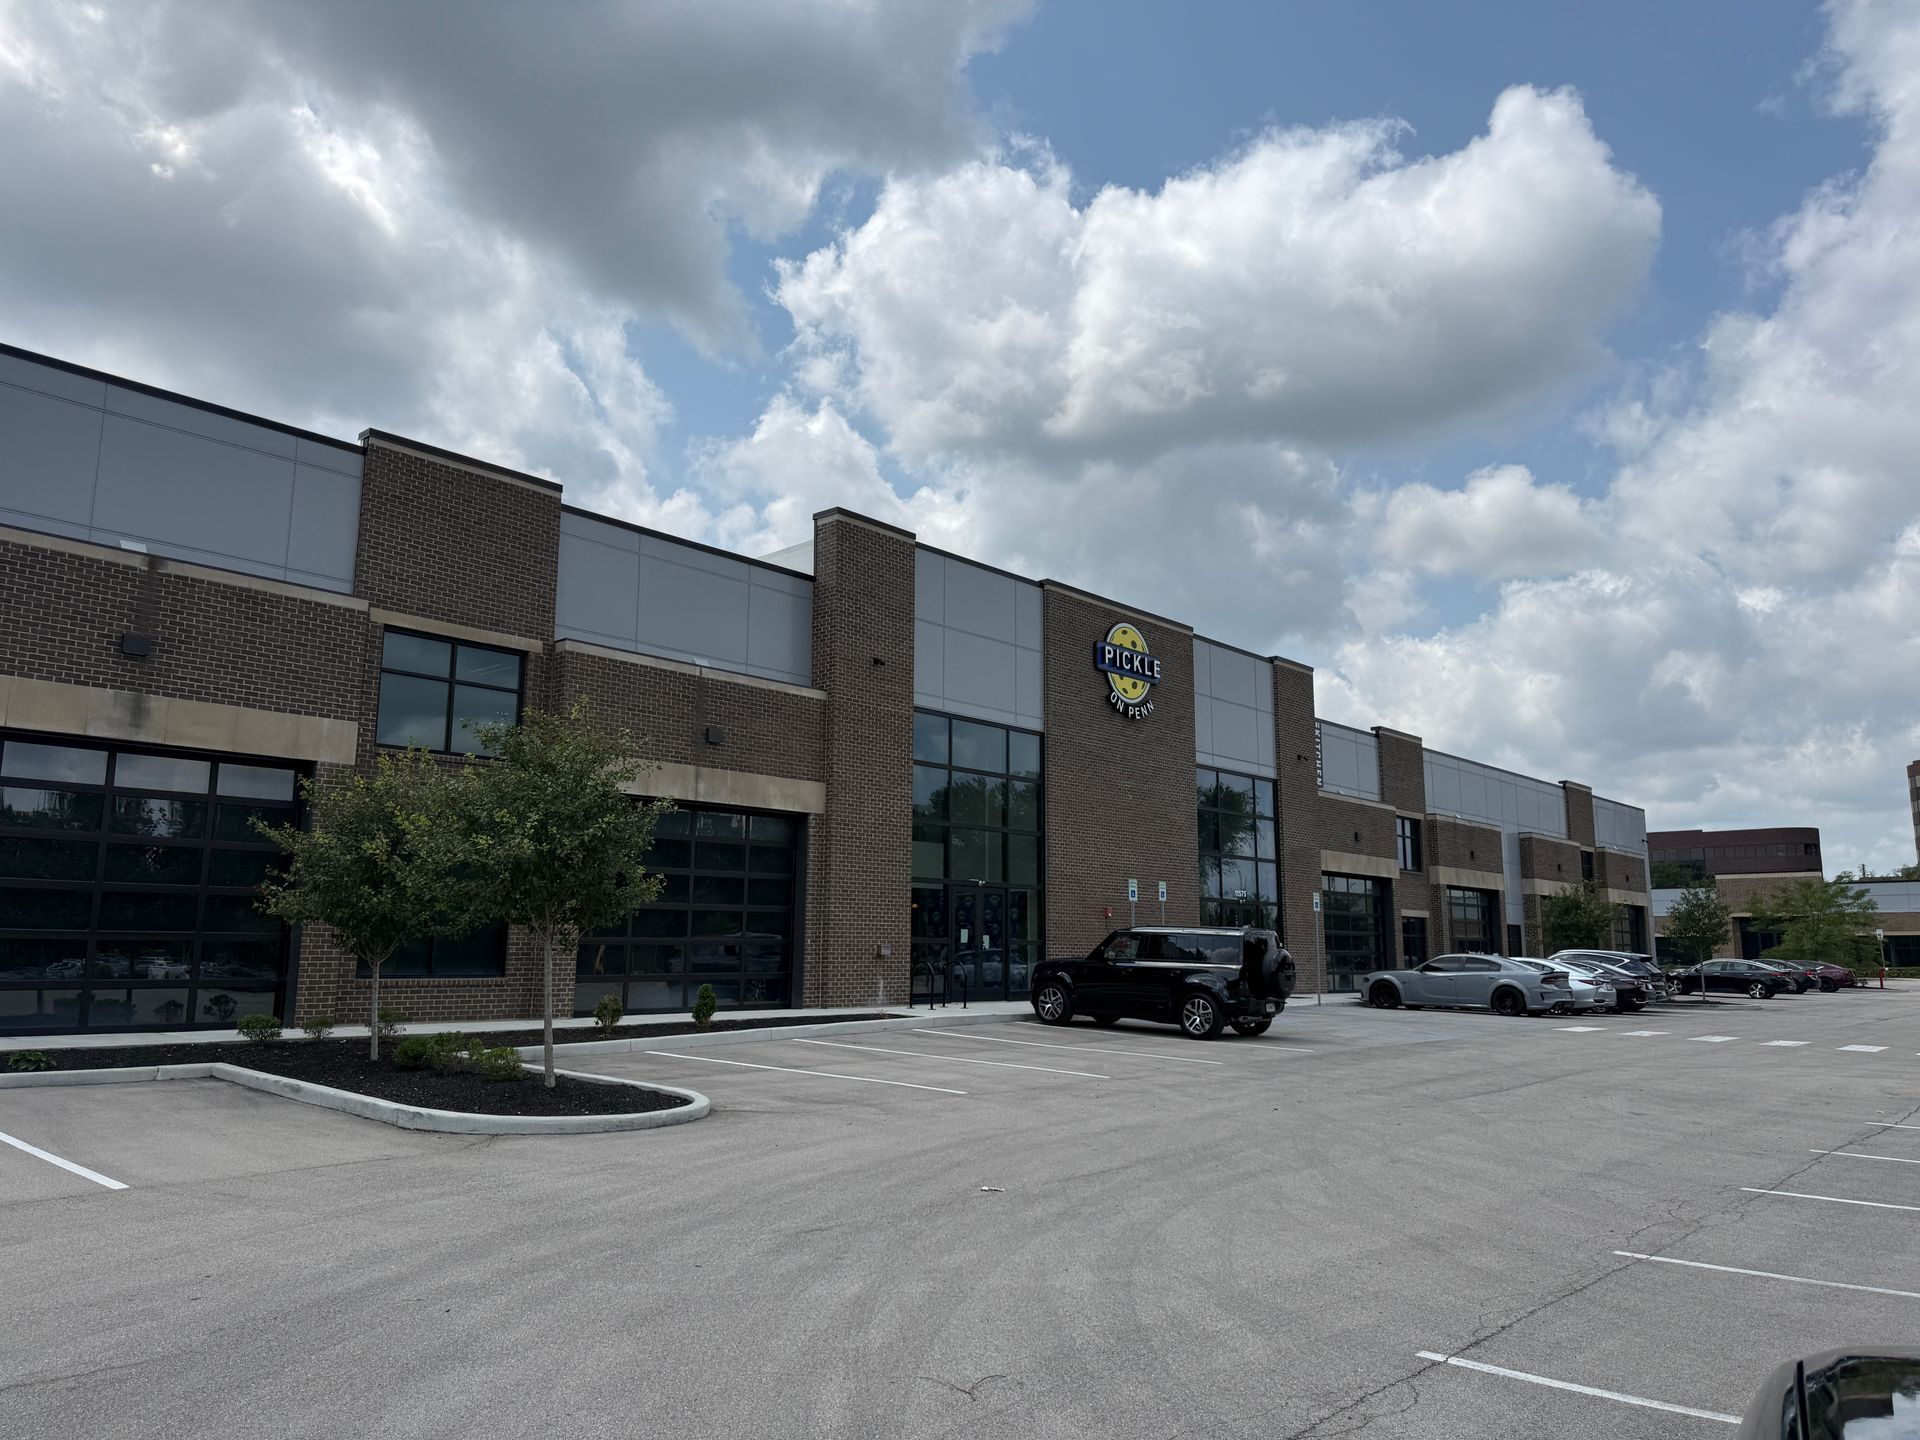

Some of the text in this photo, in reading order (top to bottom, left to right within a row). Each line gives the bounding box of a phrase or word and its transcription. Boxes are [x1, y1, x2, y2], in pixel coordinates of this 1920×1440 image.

[1105, 646, 1160, 678] PICKLE
[1110, 691, 1154, 719] ON PENN
